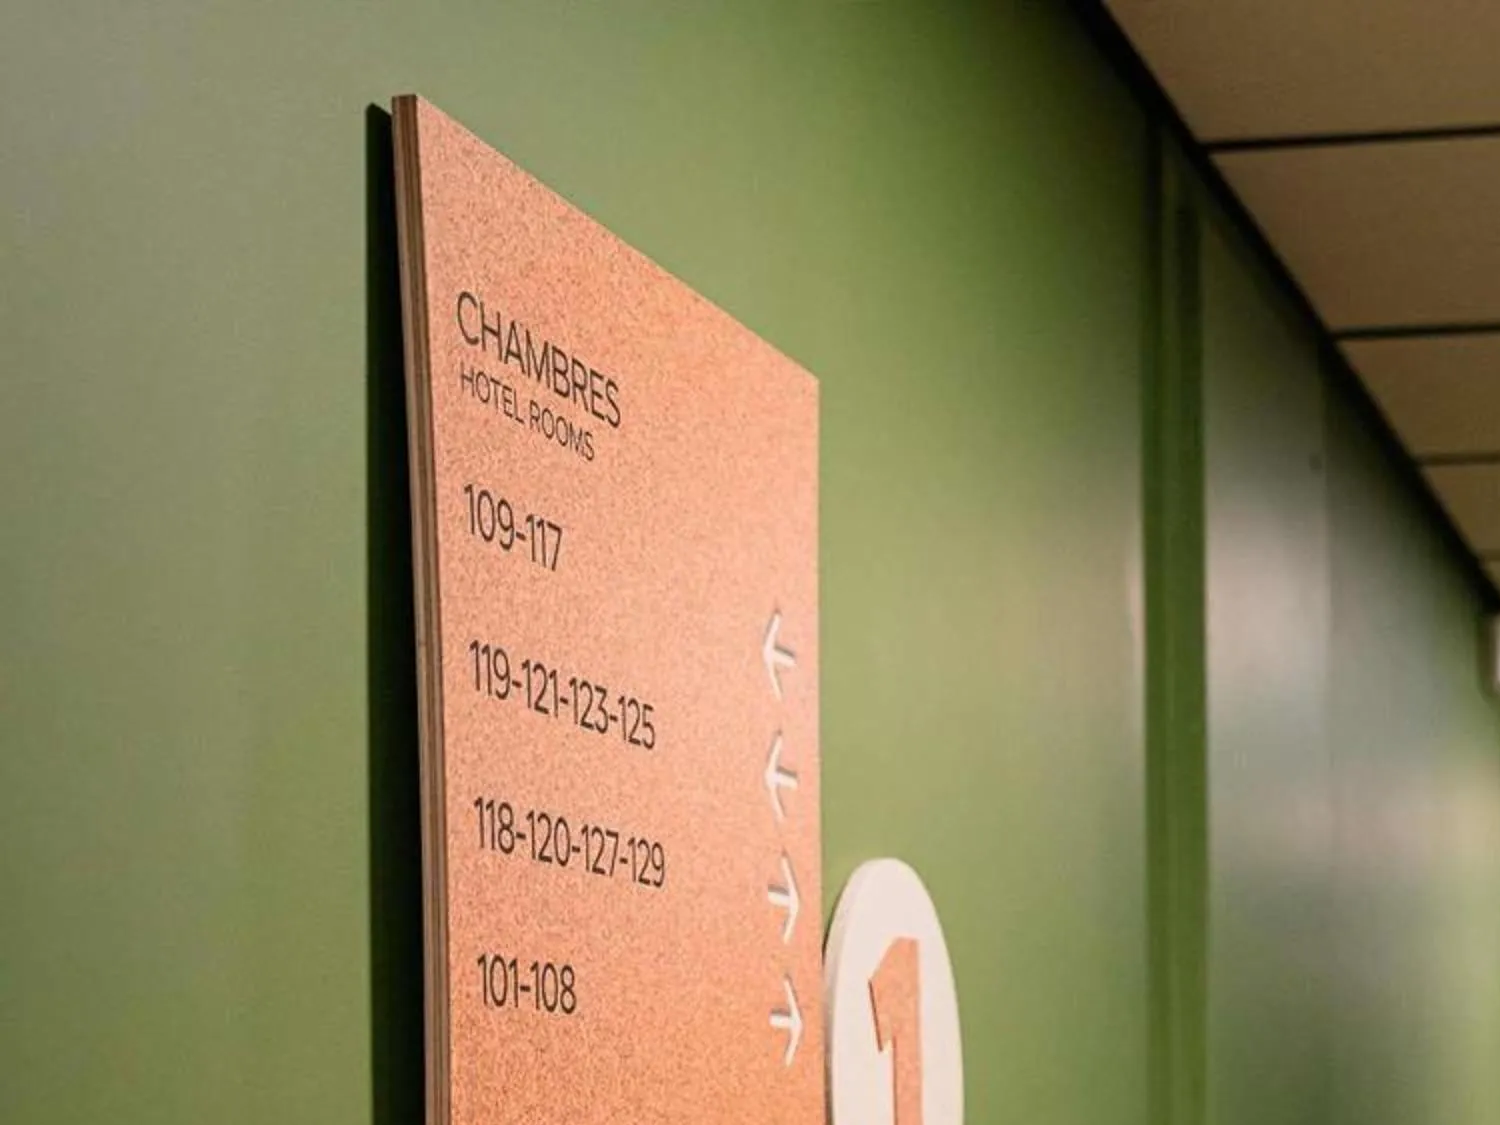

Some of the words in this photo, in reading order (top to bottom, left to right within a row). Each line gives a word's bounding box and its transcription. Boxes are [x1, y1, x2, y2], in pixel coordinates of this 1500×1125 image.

[456, 291, 622, 430] CHAMBRES
[460, 365, 525, 424] HOTEL
[529, 400, 596, 462] ROOMS
[464, 483, 563, 572] 109-117
[469, 639, 656, 750] 119-121-123-125
[473, 796, 666, 888] 118-120-127-129
[478, 954, 577, 1014] 101-108
